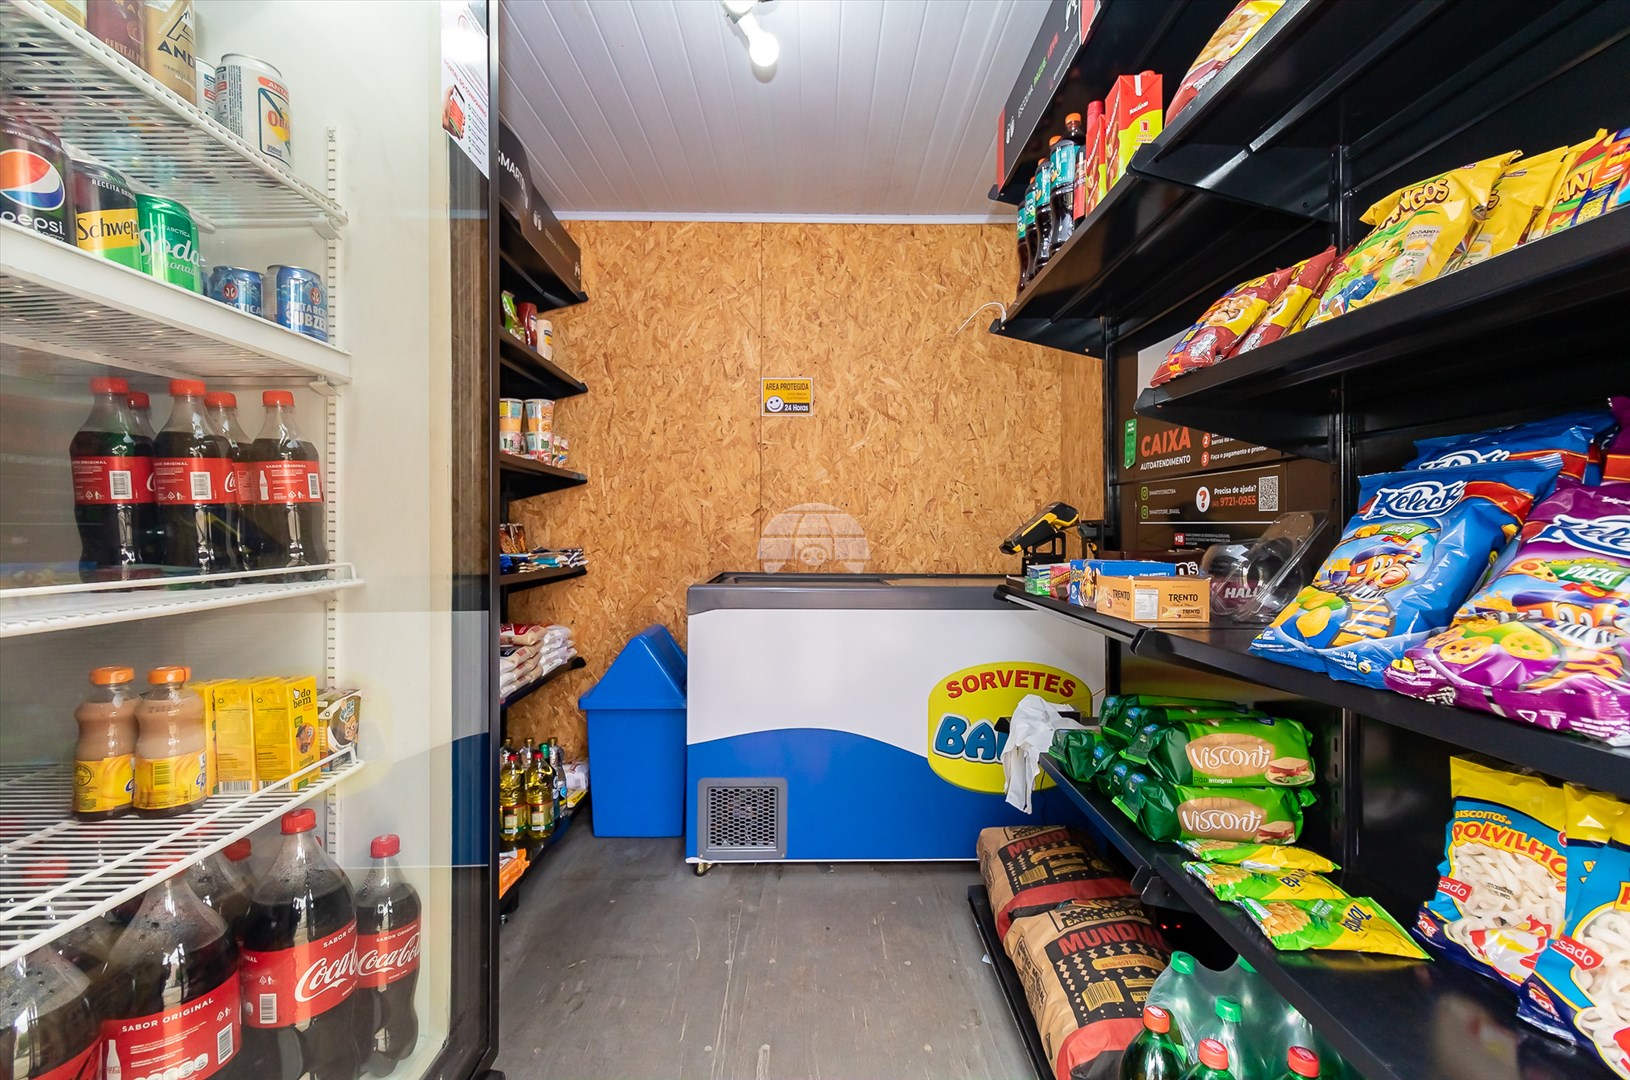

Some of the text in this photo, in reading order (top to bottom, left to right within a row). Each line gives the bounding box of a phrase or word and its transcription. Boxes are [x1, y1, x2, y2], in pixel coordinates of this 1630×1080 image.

[91, 178, 120, 193] RECEITA
[780, 382, 809, 391] PROTEGIDA
[1141, 426, 1191, 457] CAIXA
[1140, 455, 1191, 470] AUTOATENDIMENTO
[1213, 486, 1231, 495] Precisa
[1239, 484, 1257, 494] ajuda?
[1219, 495, 1257, 507] 9721-0955
[1558, 564, 1624, 586] pizza
[1113, 589, 1131, 601] TRENTO
[1168, 593, 1199, 603] TRENTO
[1224, 587, 1260, 599] HALL
[946, 670, 1076, 698] SORVETES
[300, 689, 311, 697] do
[293, 695, 311, 709] bem
[1191, 745, 1271, 769] Visconti
[1182, 809, 1262, 832] Visconti
[1453, 823, 1567, 877] POLVILHO
[1102, 909, 1127, 920] SEM
[323, 931, 347, 948] SABOR
[376, 923, 418, 943] SABOR ORIGINAL
[122, 998, 214, 1032] SABOR ORIGINAL
